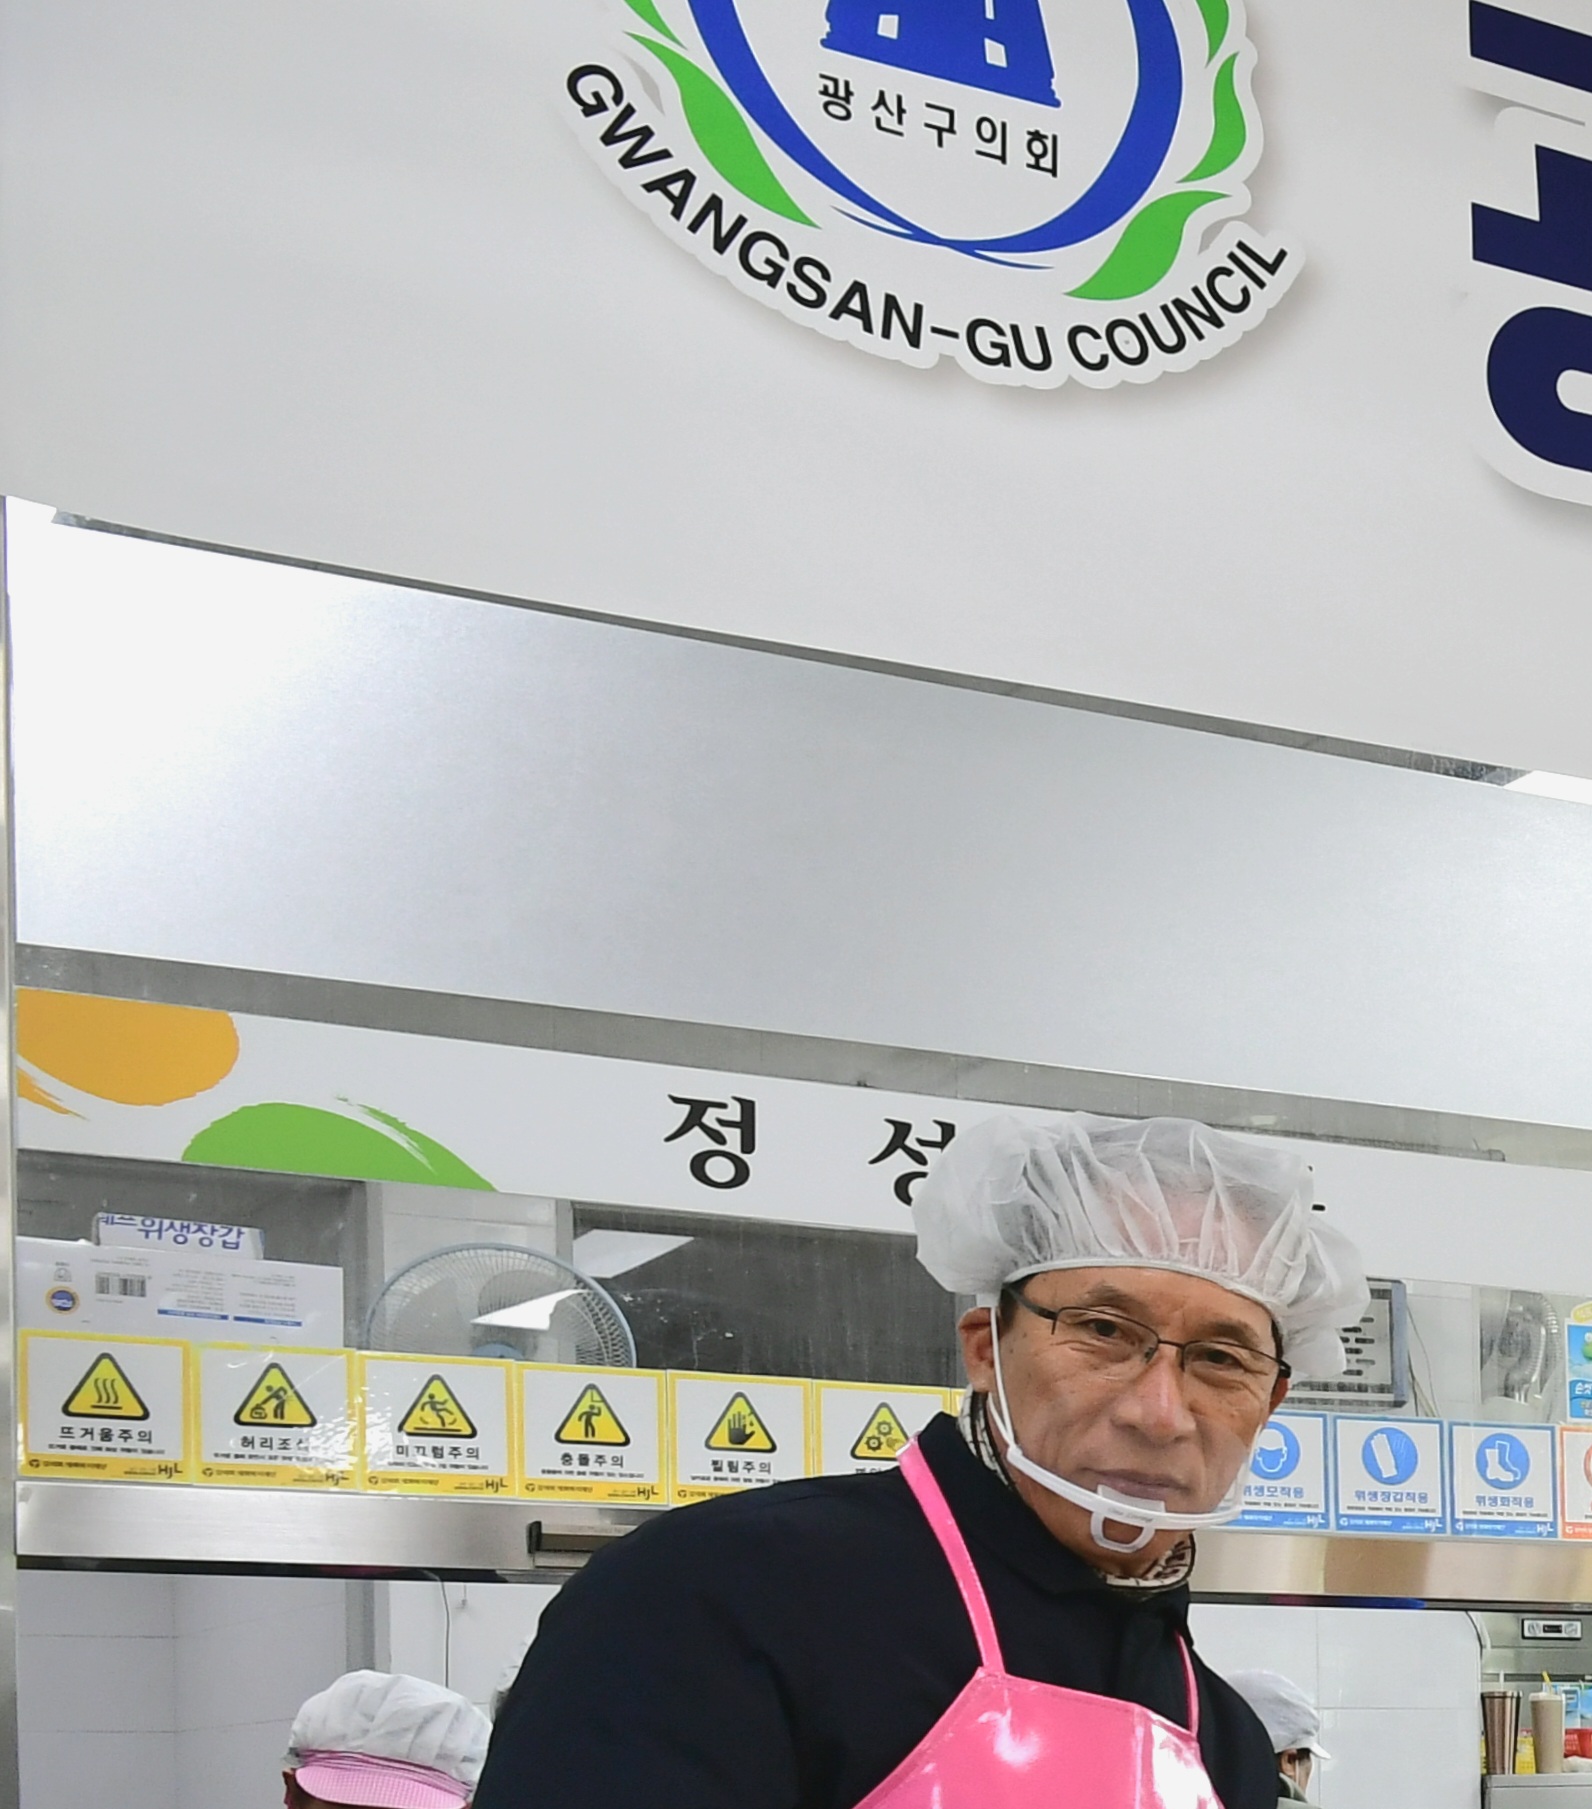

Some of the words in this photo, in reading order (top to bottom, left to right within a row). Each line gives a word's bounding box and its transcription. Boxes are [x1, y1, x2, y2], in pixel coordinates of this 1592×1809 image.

[818, 73, 1060, 178] 광산구의회
[565, 63, 1053, 372] GWANGSAN-GU
[1067, 240, 1288, 372] COUNCIL
[59, 1426, 152, 1444] 뜨거움주의
[560, 1452, 624, 1468] 충돌주의
